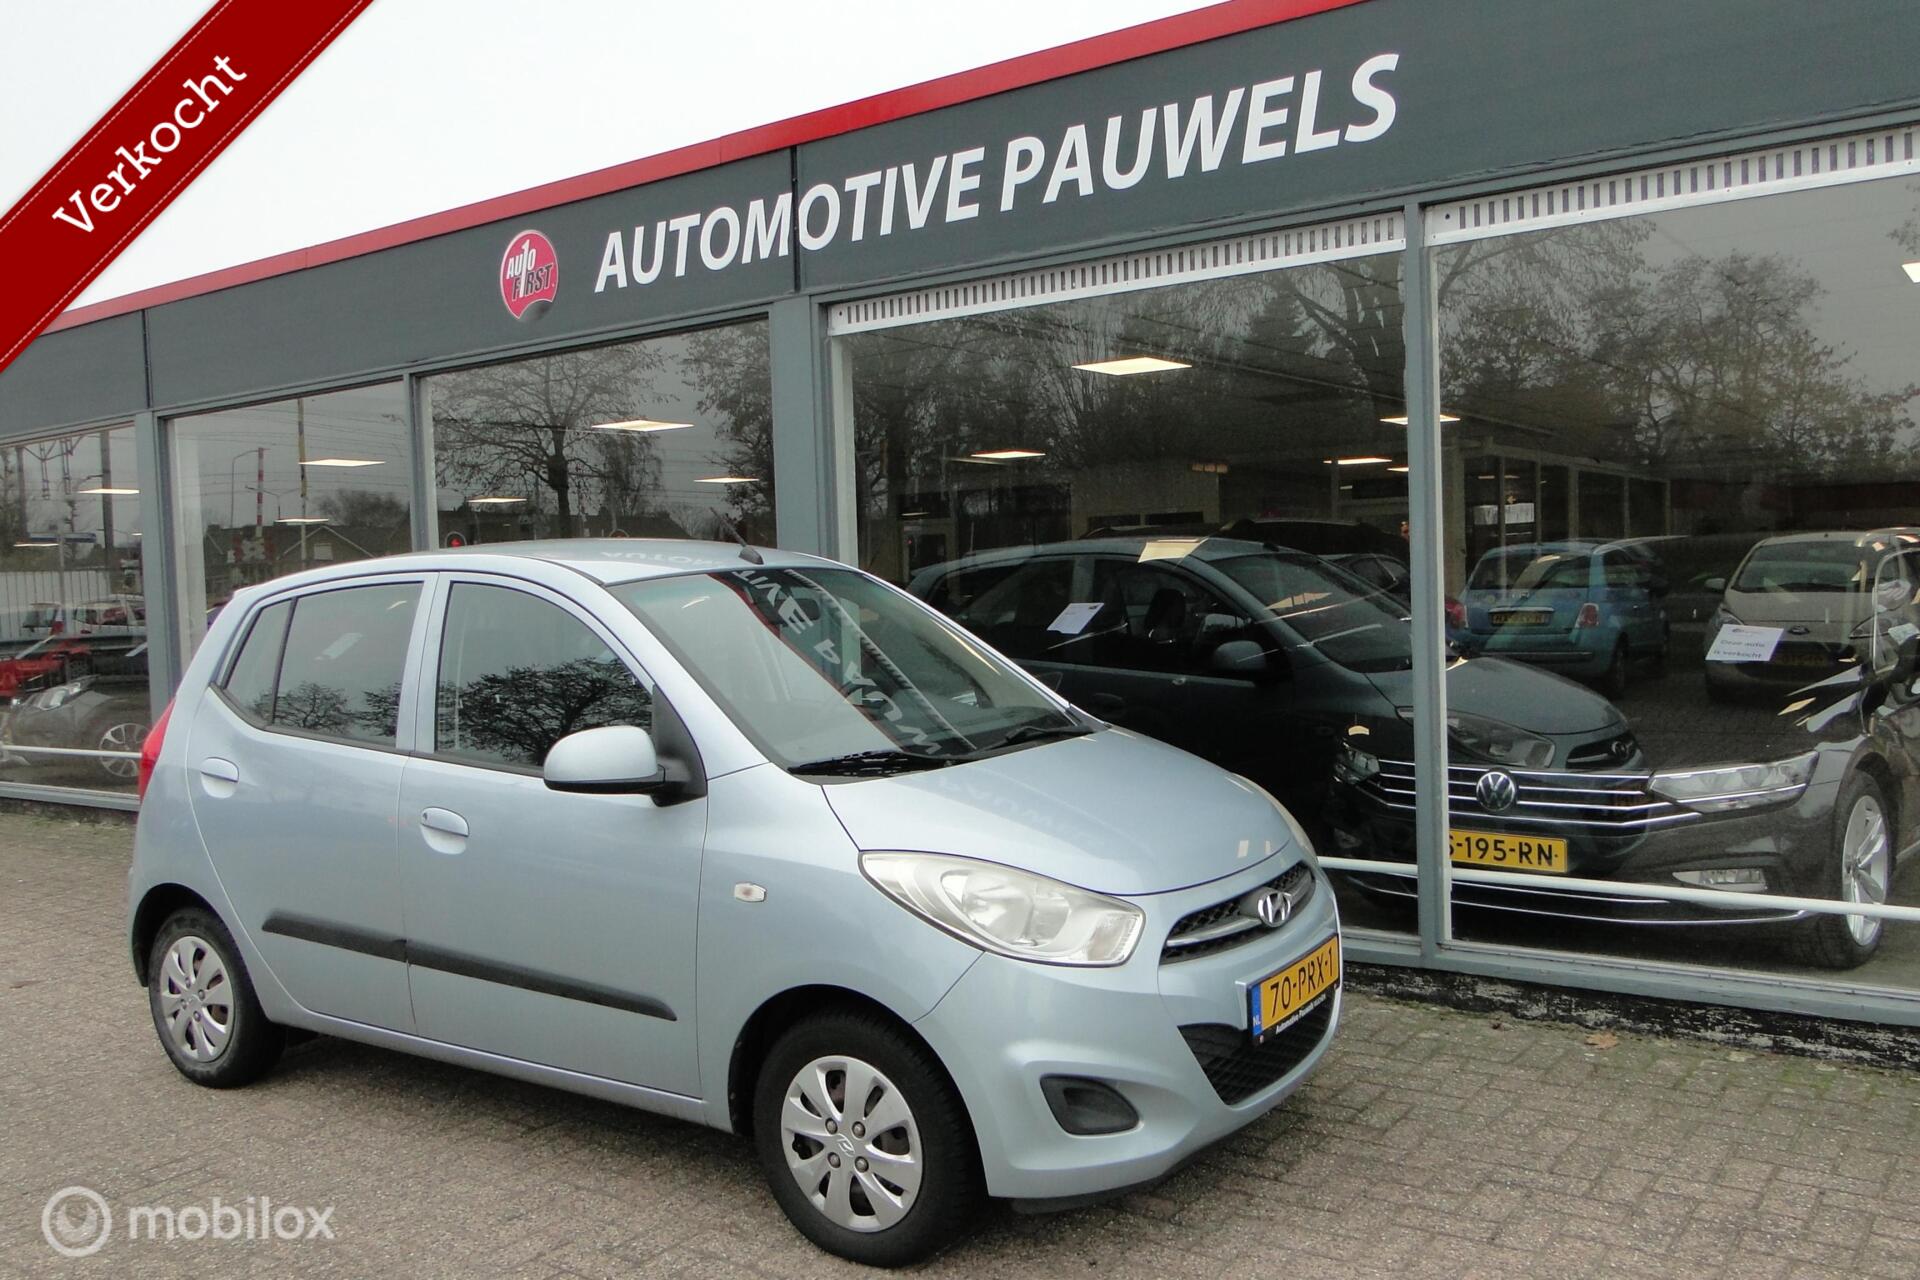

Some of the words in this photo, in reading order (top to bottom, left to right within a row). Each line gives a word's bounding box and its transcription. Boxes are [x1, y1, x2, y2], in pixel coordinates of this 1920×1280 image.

[594, 146, 985, 293] AUTOMOTIVE
[1000, 53, 1399, 212] PAUWELS
[1269, 946, 1334, 1018] 70-PRX-1
